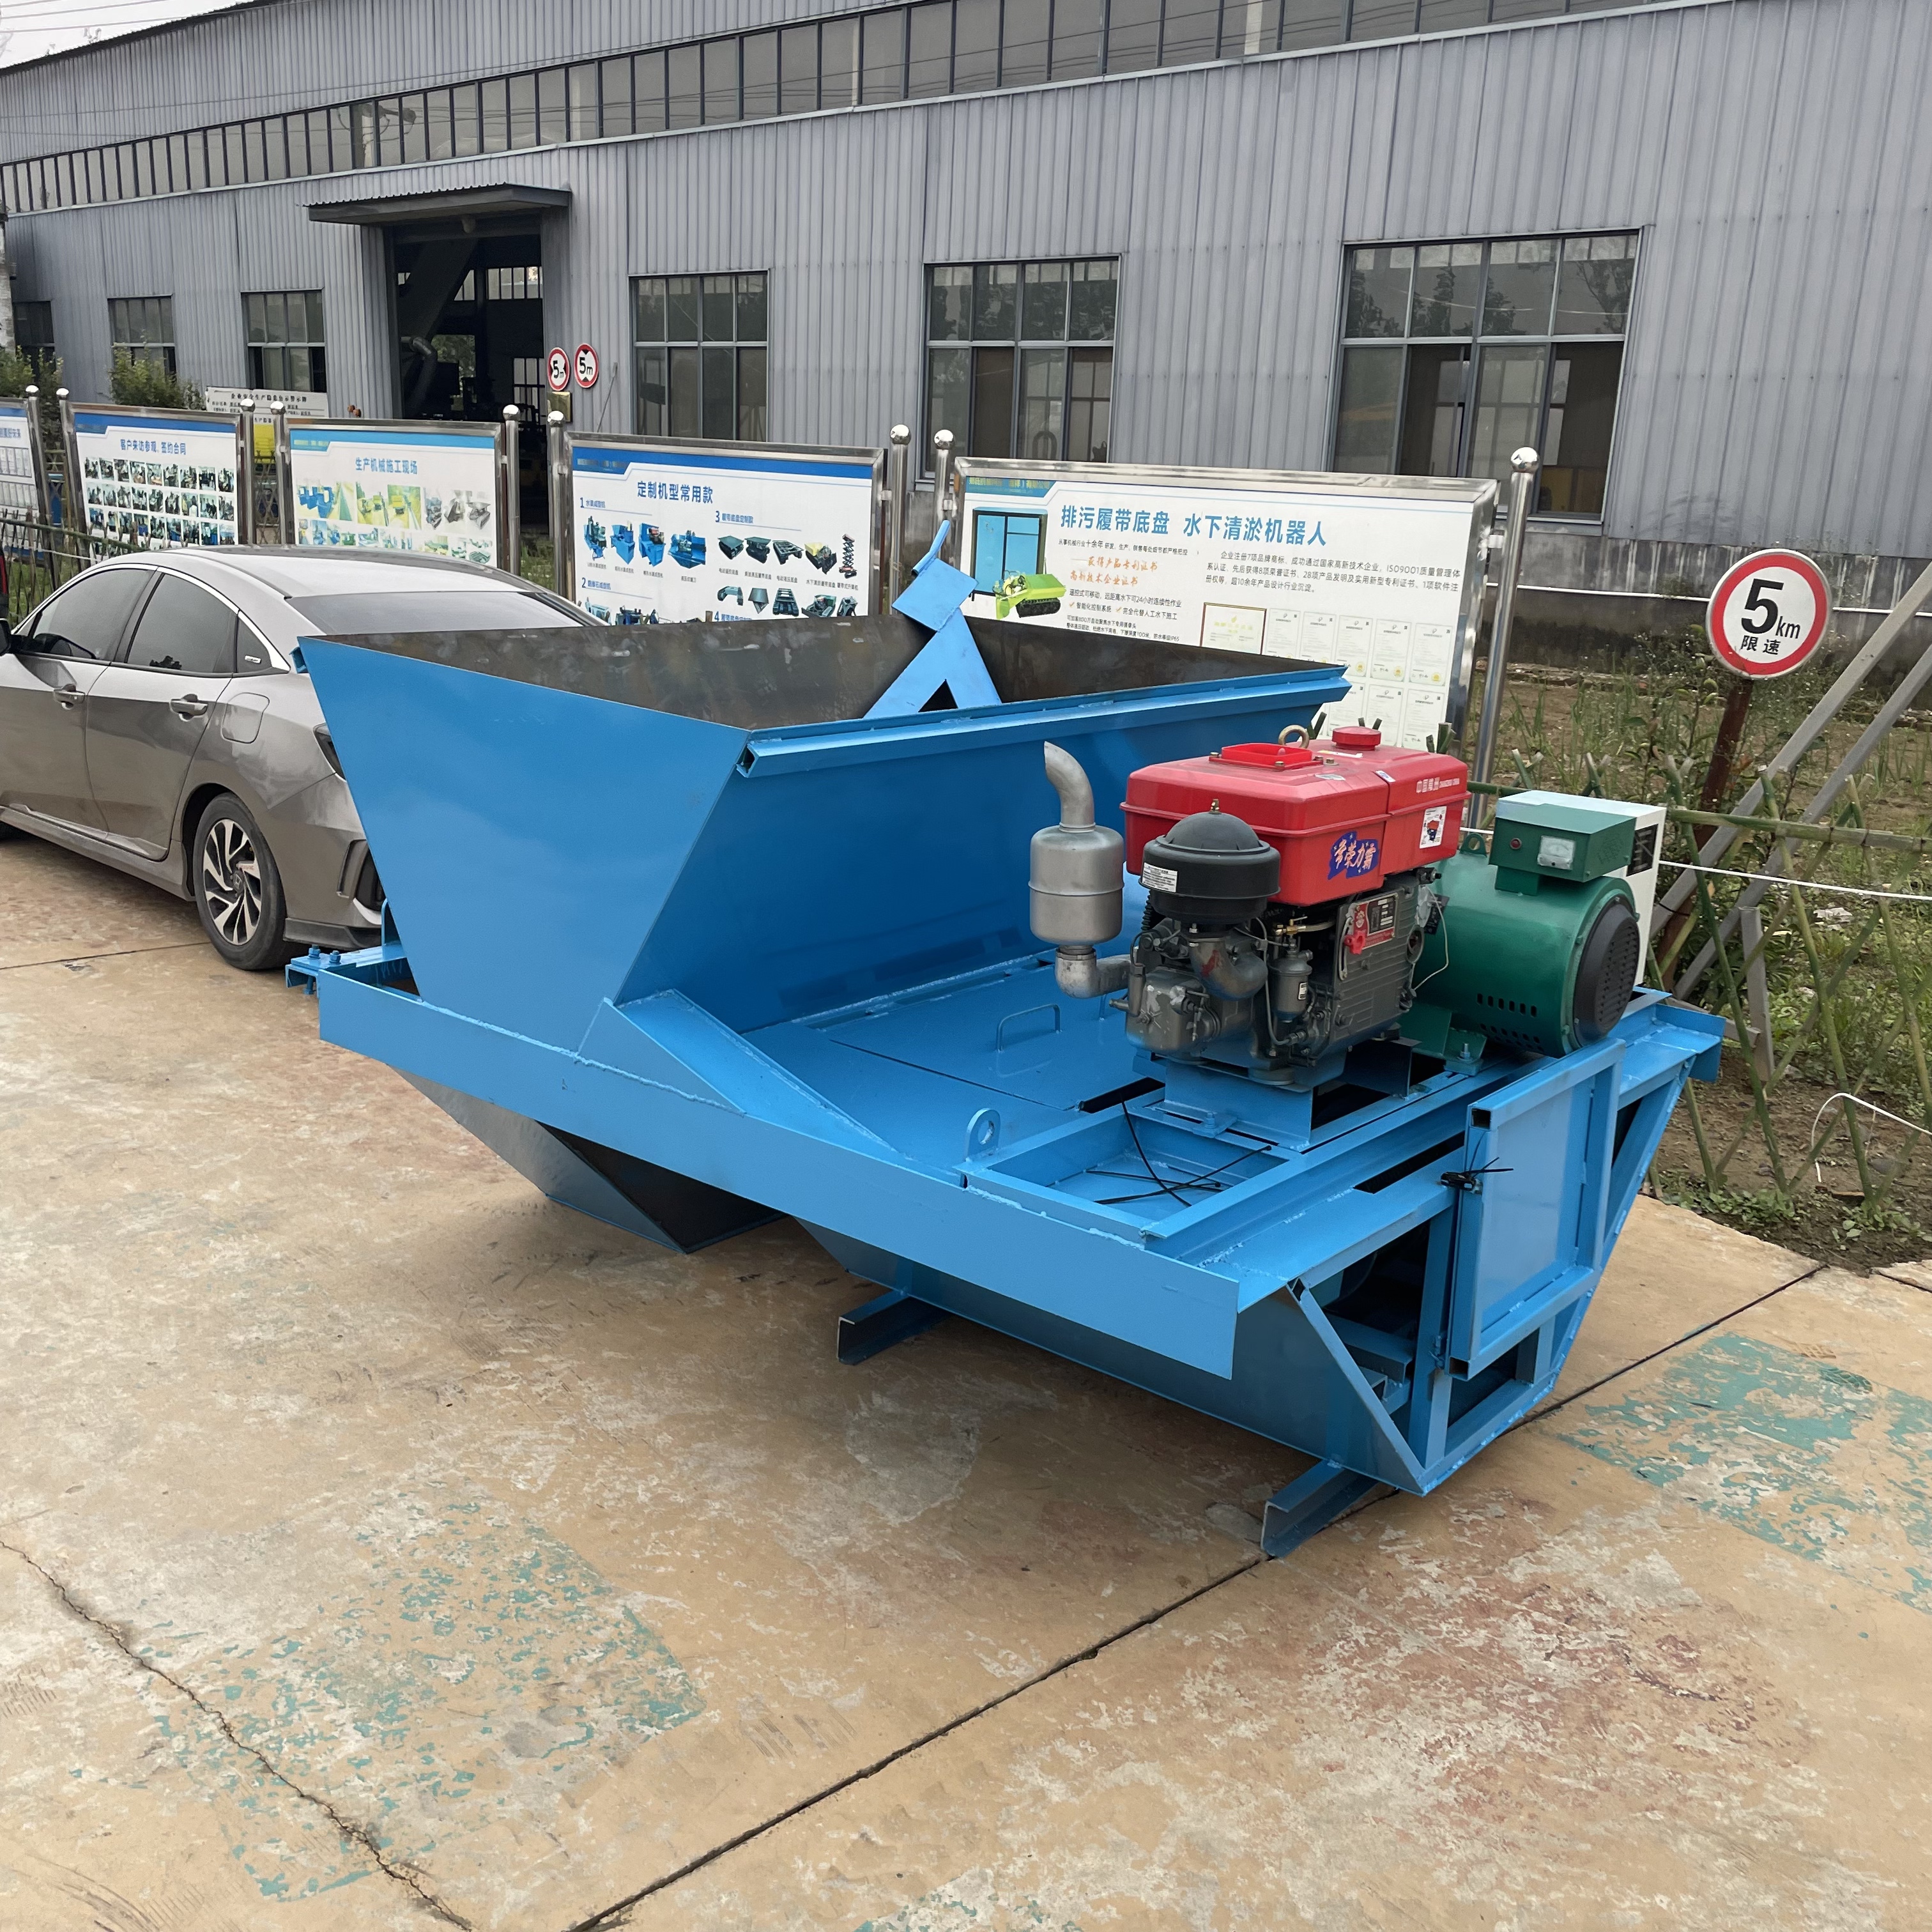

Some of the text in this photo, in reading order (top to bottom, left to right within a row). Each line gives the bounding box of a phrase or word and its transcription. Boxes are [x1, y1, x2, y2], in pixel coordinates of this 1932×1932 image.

[120, 439, 187, 456] 客户来访参观、签约合同
[355, 457, 418, 475] 生产机械施工现场
[637, 480, 713, 504] 定制机型常用款
[715, 510, 720, 523] 3
[1061, 505, 1326, 546] 排污履带底盘 水下清淤机器人
[1088, 556, 1158, 572] 获得产品专利证书
[1220, 551, 1460, 578] 企业注册7项品牌商标、成功通过国家高新技术企业，ISO9001质量管理体
[581, 577, 586, 588] 2
[1070, 570, 1138, 586] 高新技术企业证书
[714, 611, 719, 622] 4
[1077, 602, 1177, 620] 智能化控制系统 完全代替人工水下施工
[1740, 634, 1781, 656] 限速
